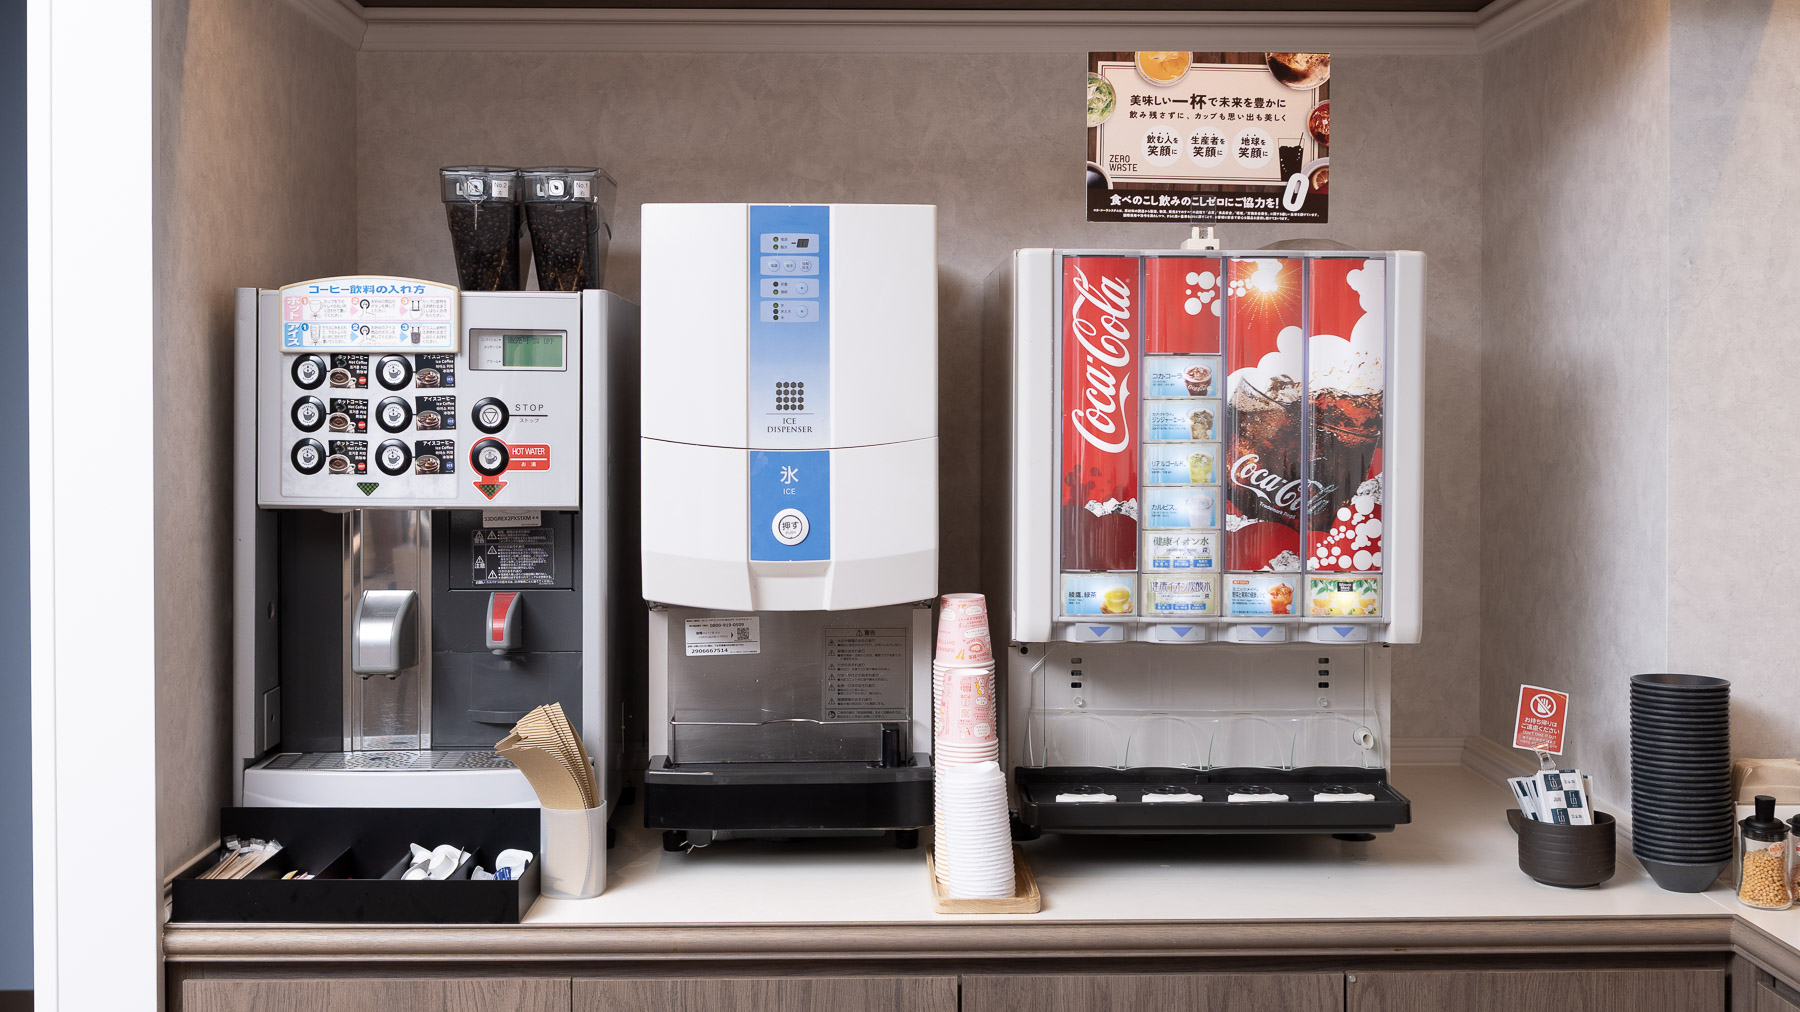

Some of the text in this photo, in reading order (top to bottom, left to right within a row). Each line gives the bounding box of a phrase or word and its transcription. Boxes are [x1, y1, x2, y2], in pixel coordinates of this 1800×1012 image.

[1130, 93, 1286, 110] 美味しい一杯で未来を豊かに
[1147, 134, 1179, 145] 飲む人を
[1191, 135, 1225, 145] 生産者を
[1241, 136, 1266, 146] 地球を
[1148, 146, 1178, 157] 笑顔に
[1193, 146, 1223, 158] 笑顔に
[1238, 147, 1268, 158] 笑顔に
[1109, 155, 1130, 163] ZERO
[1109, 163, 1138, 172] WASTE
[308, 285, 426, 294] コーヒー飲料の入れ方
[287, 297, 300, 320] ホット
[287, 324, 300, 346] アイス
[1071, 264, 1131, 453] Coca-Cola
[780, 465, 799, 484] 氷
[782, 521, 798, 530] 押す
[1153, 537, 1209, 546] 健康イオン水
[1150, 582, 1212, 593] 健康イオン炭酸水
[1525, 717, 1557, 727] お持ち帰りは
[1521, 723, 1560, 734] ご遠慮ください
